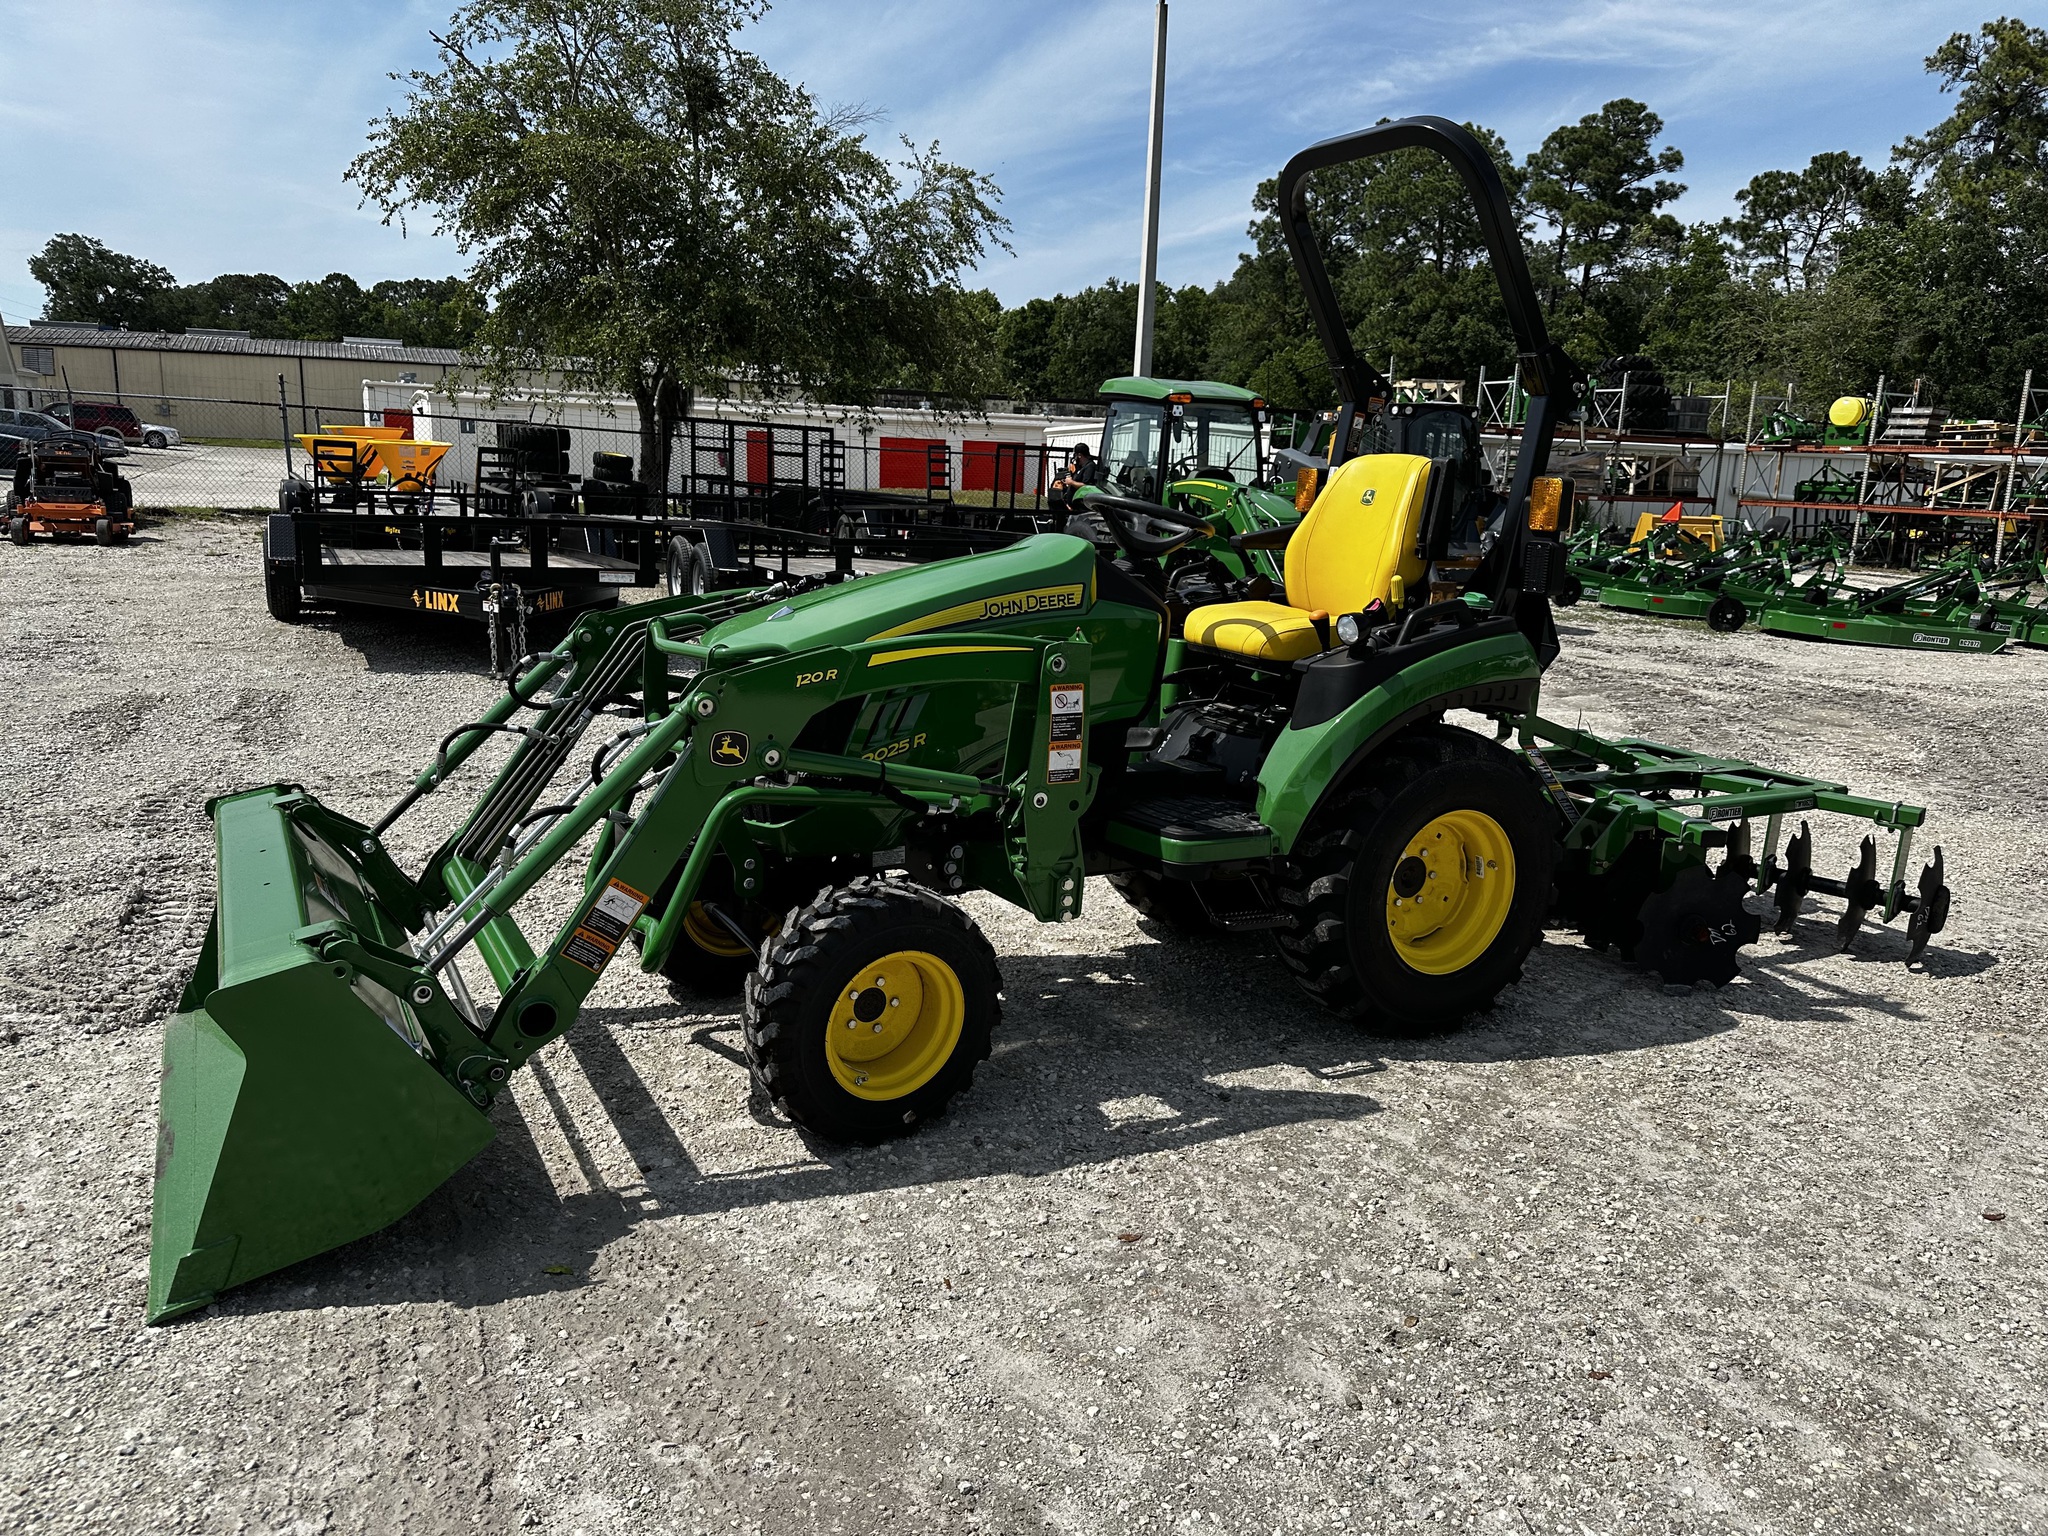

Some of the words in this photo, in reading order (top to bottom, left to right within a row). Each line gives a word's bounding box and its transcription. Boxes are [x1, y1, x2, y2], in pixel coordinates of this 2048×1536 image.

[425, 590, 460, 613] LINX
[545, 590, 564, 610] LINX
[979, 597, 1023, 619] JOHN
[1026, 593, 1077, 611] DEERE
[796, 671, 824, 688] 120
[825, 668, 838, 681] R
[1056, 684, 1082, 692] WARNING
[913, 732, 927, 749] R
[1708, 806, 1742, 820] FRONTIER
[619, 884, 644, 901] WARNING
[585, 933, 610, 951] WARNING
